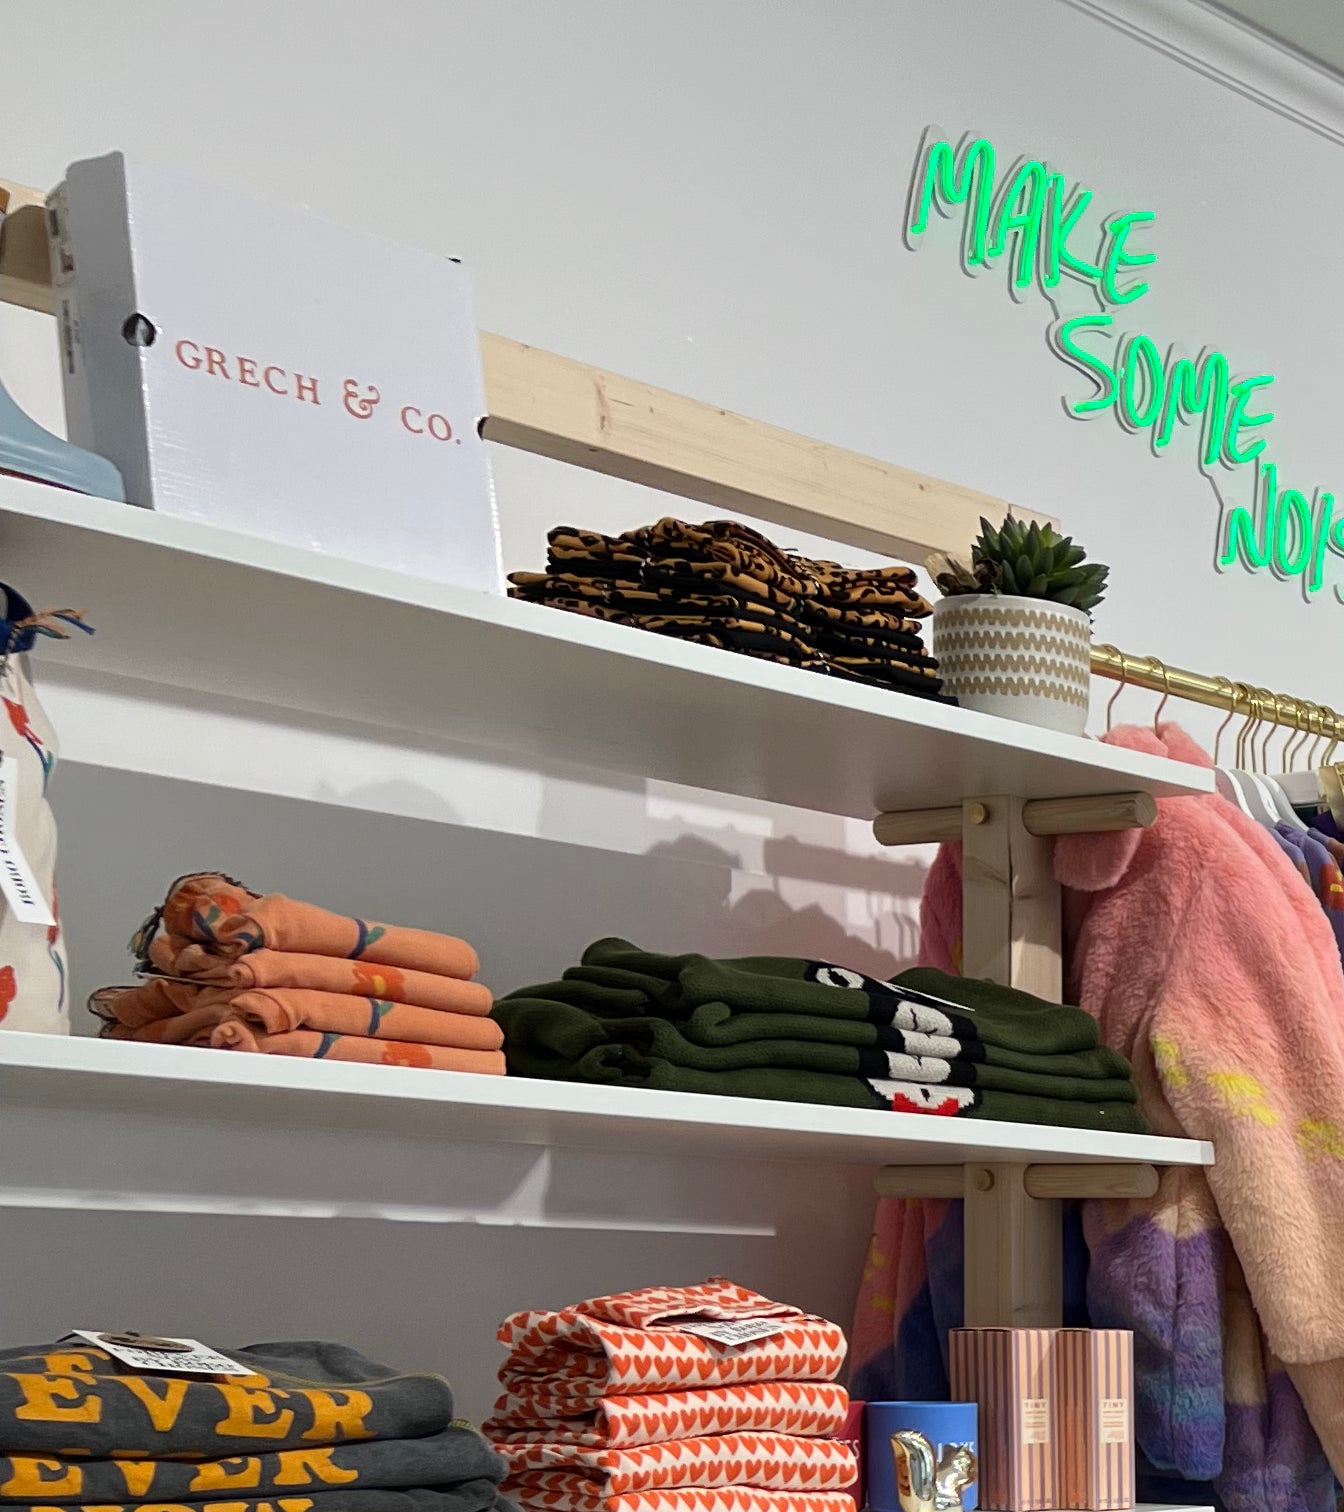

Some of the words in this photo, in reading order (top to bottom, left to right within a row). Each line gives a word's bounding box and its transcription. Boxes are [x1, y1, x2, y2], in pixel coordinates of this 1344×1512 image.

[911, 139, 1157, 304] MAKE
[175, 339, 321, 405] GRECH
[341, 378, 381, 419] &
[400, 405, 462, 445] CO.
[1060, 315, 1275, 465] SOME
[14, 1373, 376, 1441] EVER
